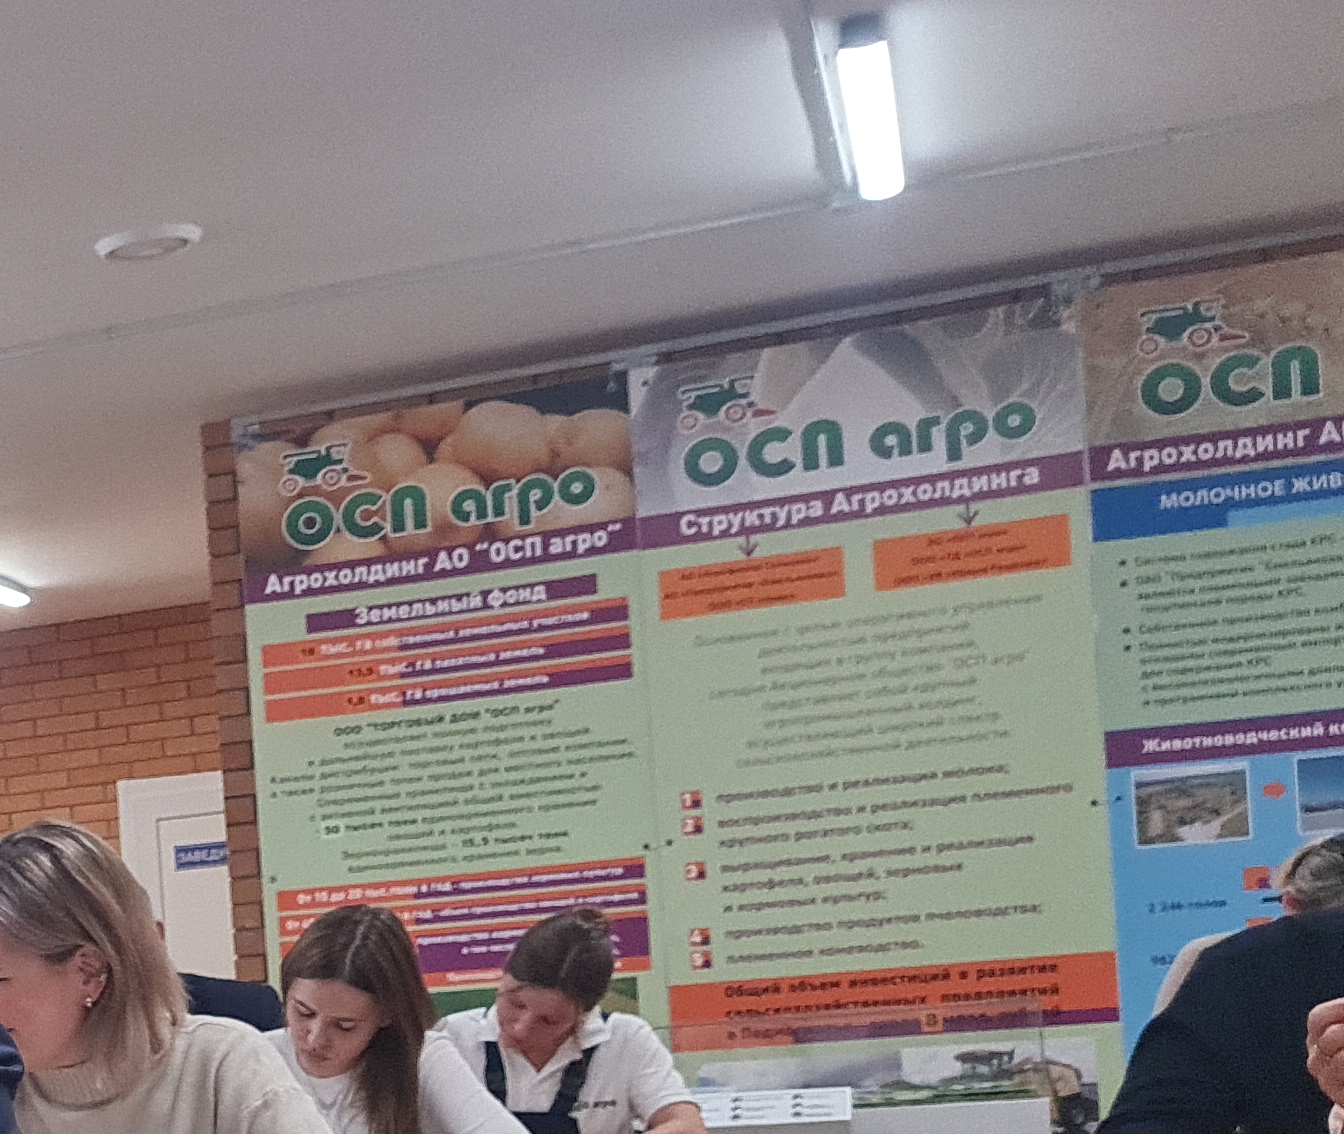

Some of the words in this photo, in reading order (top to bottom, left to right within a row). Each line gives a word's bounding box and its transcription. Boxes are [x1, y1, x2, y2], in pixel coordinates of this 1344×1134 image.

[1140, 344, 1322, 417] ОСП
[683, 416, 847, 488] ОСП
[868, 399, 1038, 463] агро
[1106, 426, 1312, 473] Агрохолдинг
[1318, 420, 1344, 446] А
[284, 483, 430, 550] ОСП
[449, 468, 597, 529] агро
[679, 498, 824, 539] Структура
[831, 463, 1041, 518] Агрохолдинга
[1159, 479, 1287, 510] МОЛОЧНОЕ
[263, 555, 427, 596] Агрохолдинг
[432, 546, 470, 573] АО
[354, 590, 484, 626] Земельный
[487, 583, 548, 610] фонд
